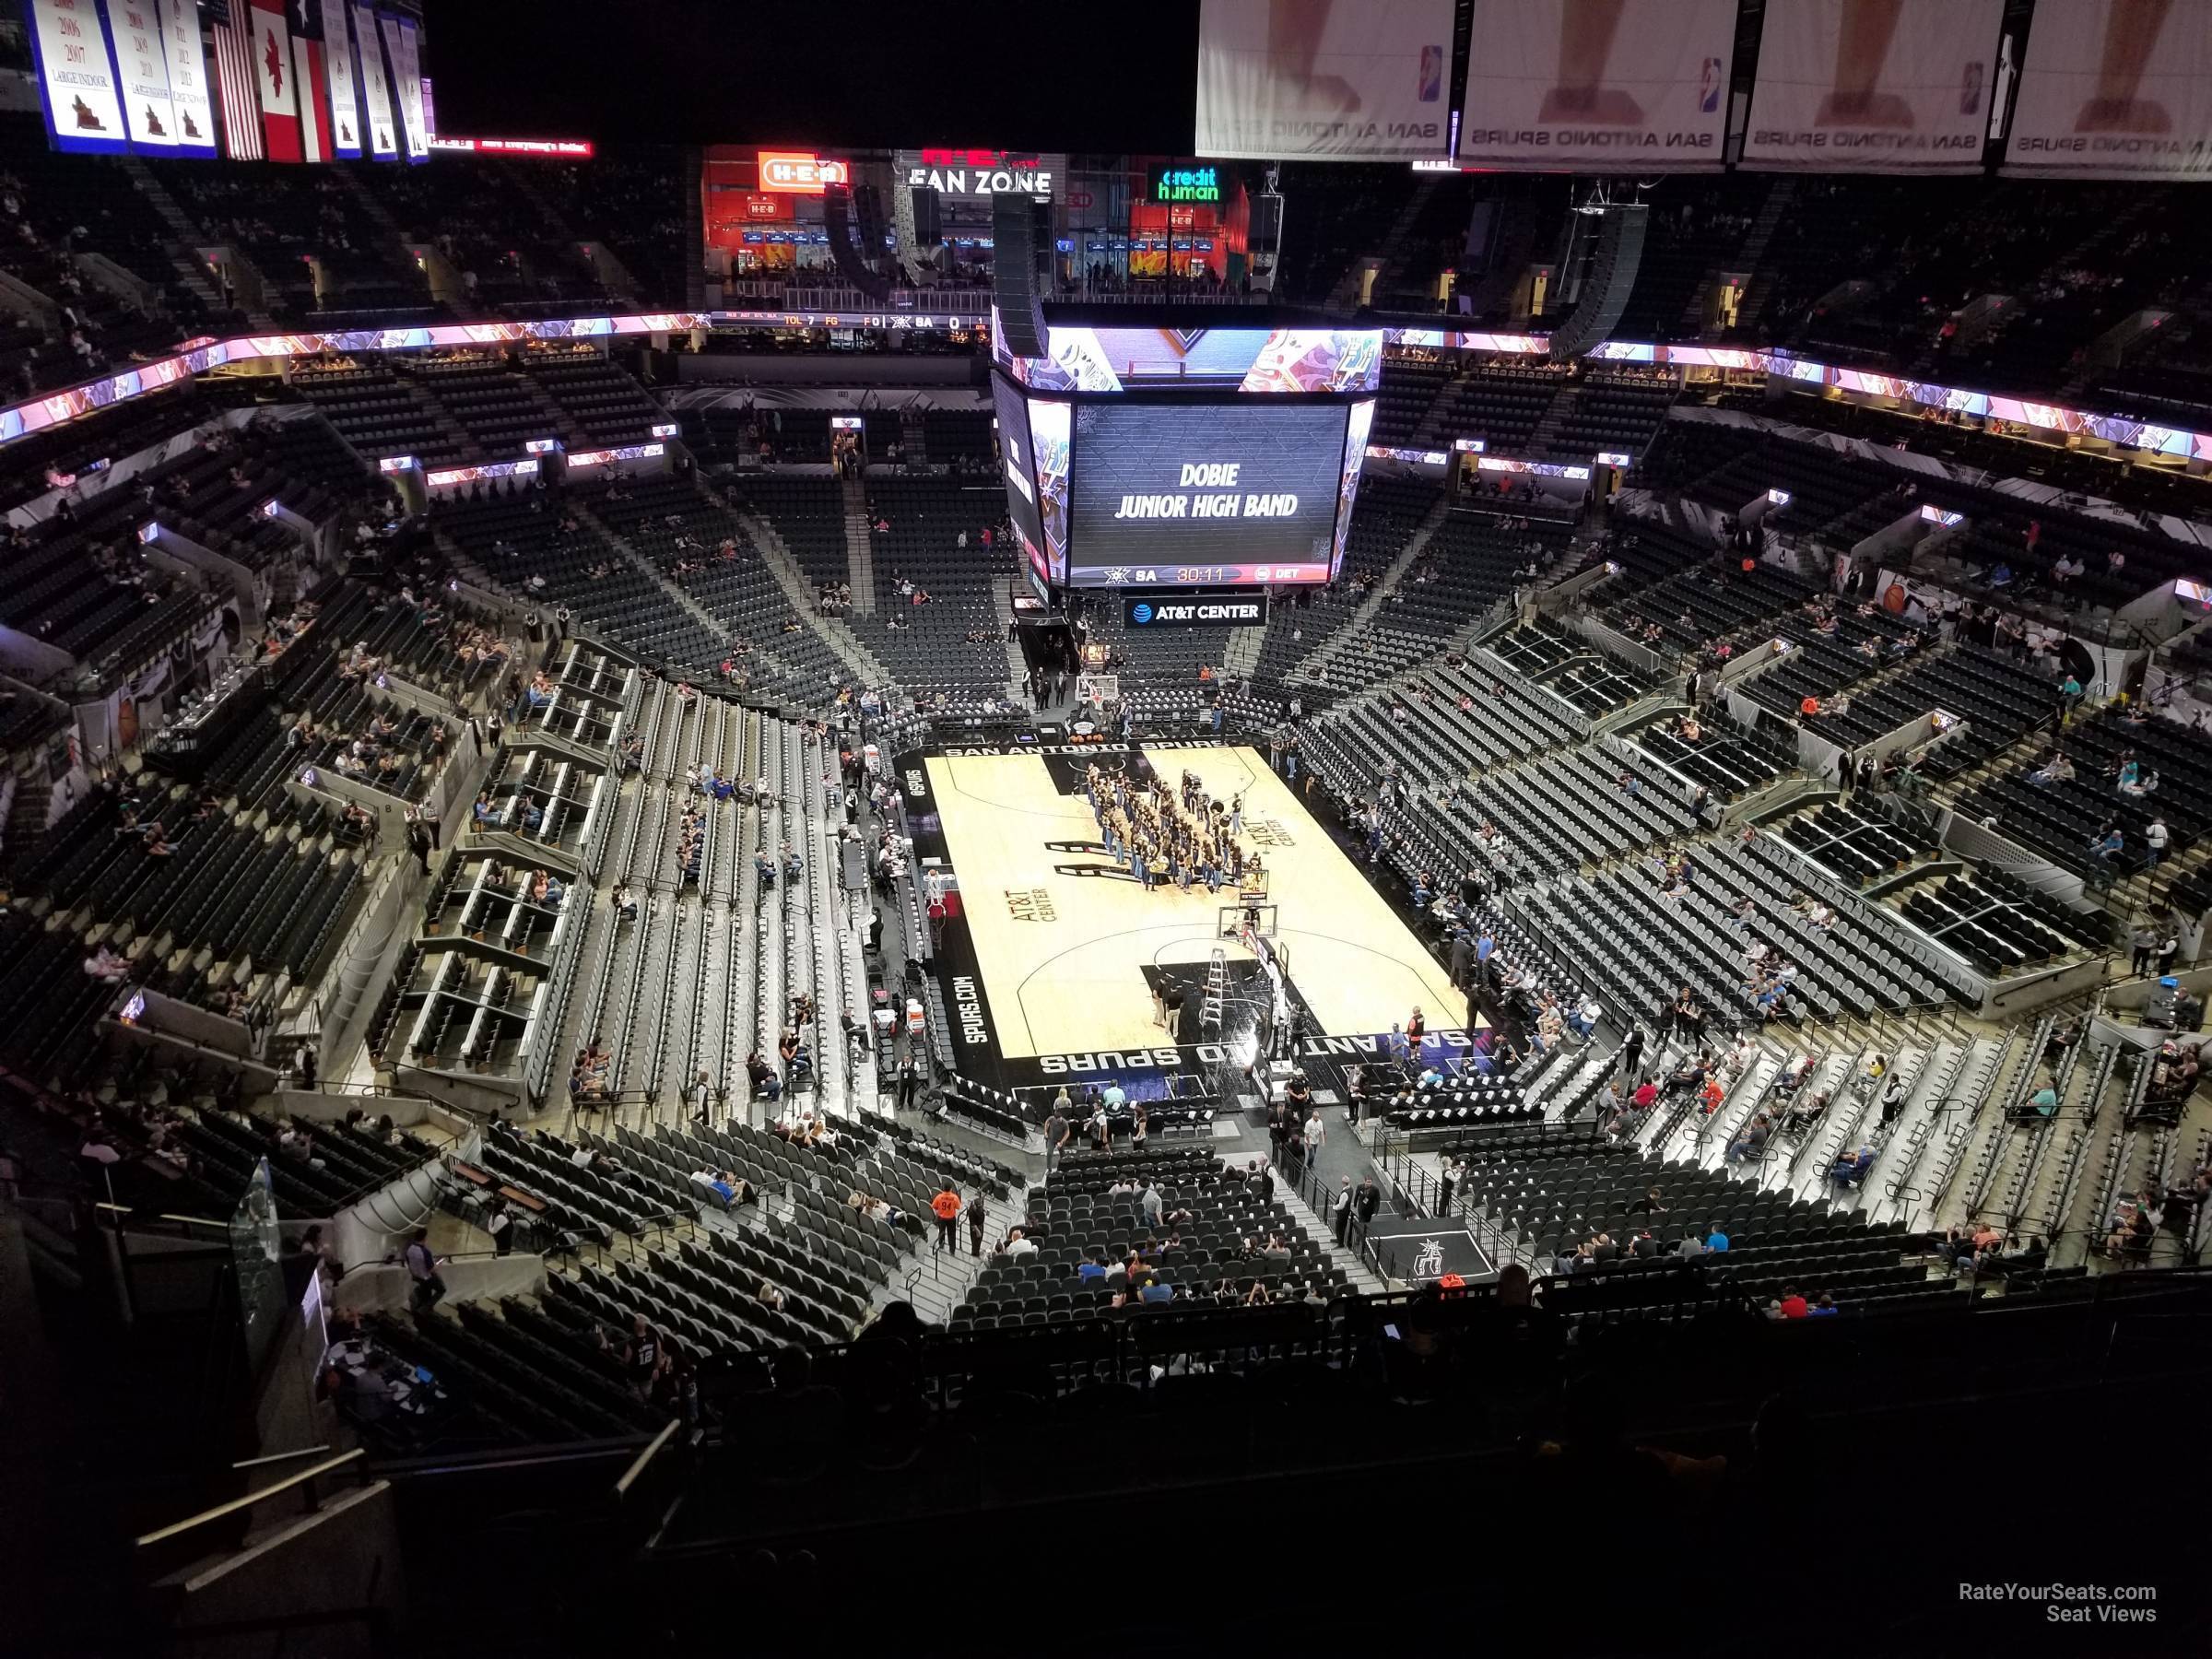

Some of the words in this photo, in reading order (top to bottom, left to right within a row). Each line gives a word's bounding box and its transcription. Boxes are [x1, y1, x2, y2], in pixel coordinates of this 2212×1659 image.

[58, 17, 81, 37] 2006
[65, 44, 87, 65] 2007
[52, 69, 79, 85] LARGE
[909, 169, 966, 194] FAN
[974, 171, 1052, 194] ZONE
[1163, 168, 1216, 186] credit
[1158, 182, 1219, 201] human
[783, 315, 803, 324] TOL
[807, 315, 815, 325] 7
[825, 316, 838, 325] FG
[872, 316, 880, 326] 0
[915, 316, 934, 328] SA
[948, 316, 960, 330] 0
[1179, 463, 1241, 488] DOBIE
[1114, 494, 1188, 519] JUNIOR
[1191, 494, 1241, 518] HIGH
[1242, 493, 1299, 517] BAND
[1135, 570, 1157, 582] SA
[1176, 568, 1223, 582] 30:11
[1274, 568, 1300, 580] DET
[1155, 606, 1194, 620] AT&T
[1196, 604, 1259, 619] CENTER
[945, 747, 1001, 758] SAN
[1008, 744, 1130, 756] ANTONIO
[1138, 740, 1230, 751] SPURS
[905, 770, 926, 796] @SPURS
[1241, 820, 1281, 847] AT&T
[1005, 890, 1039, 923] AT&T
[1031, 888, 1057, 923] CENTER
[952, 976, 988, 1044] SPURS.COM
[1040, 1048, 1182, 1074] SPURS
